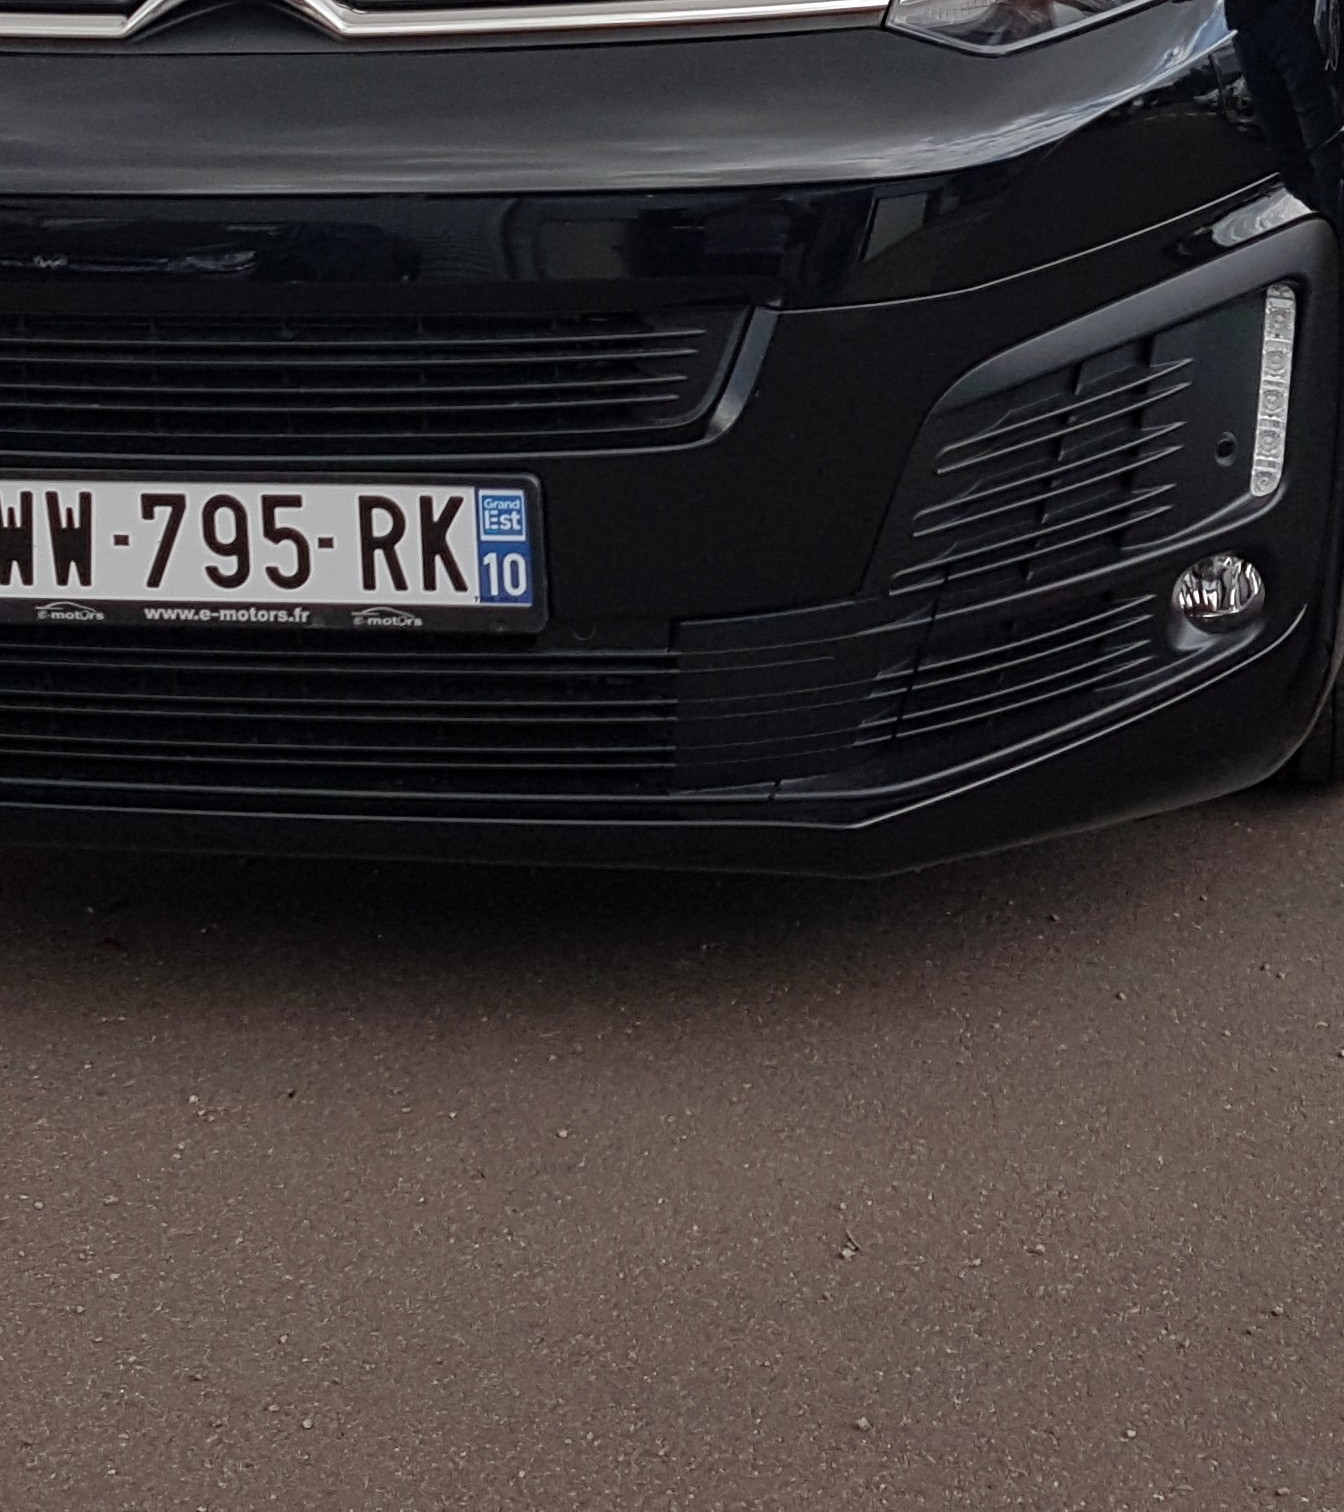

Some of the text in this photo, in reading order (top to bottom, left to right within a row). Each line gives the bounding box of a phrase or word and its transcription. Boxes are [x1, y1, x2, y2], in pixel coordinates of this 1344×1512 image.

[483, 498, 521, 510] Grand
[484, 509, 522, 530] Est
[483, 551, 528, 597] 10
[143, 607, 311, 624] www.e-motors.fr
